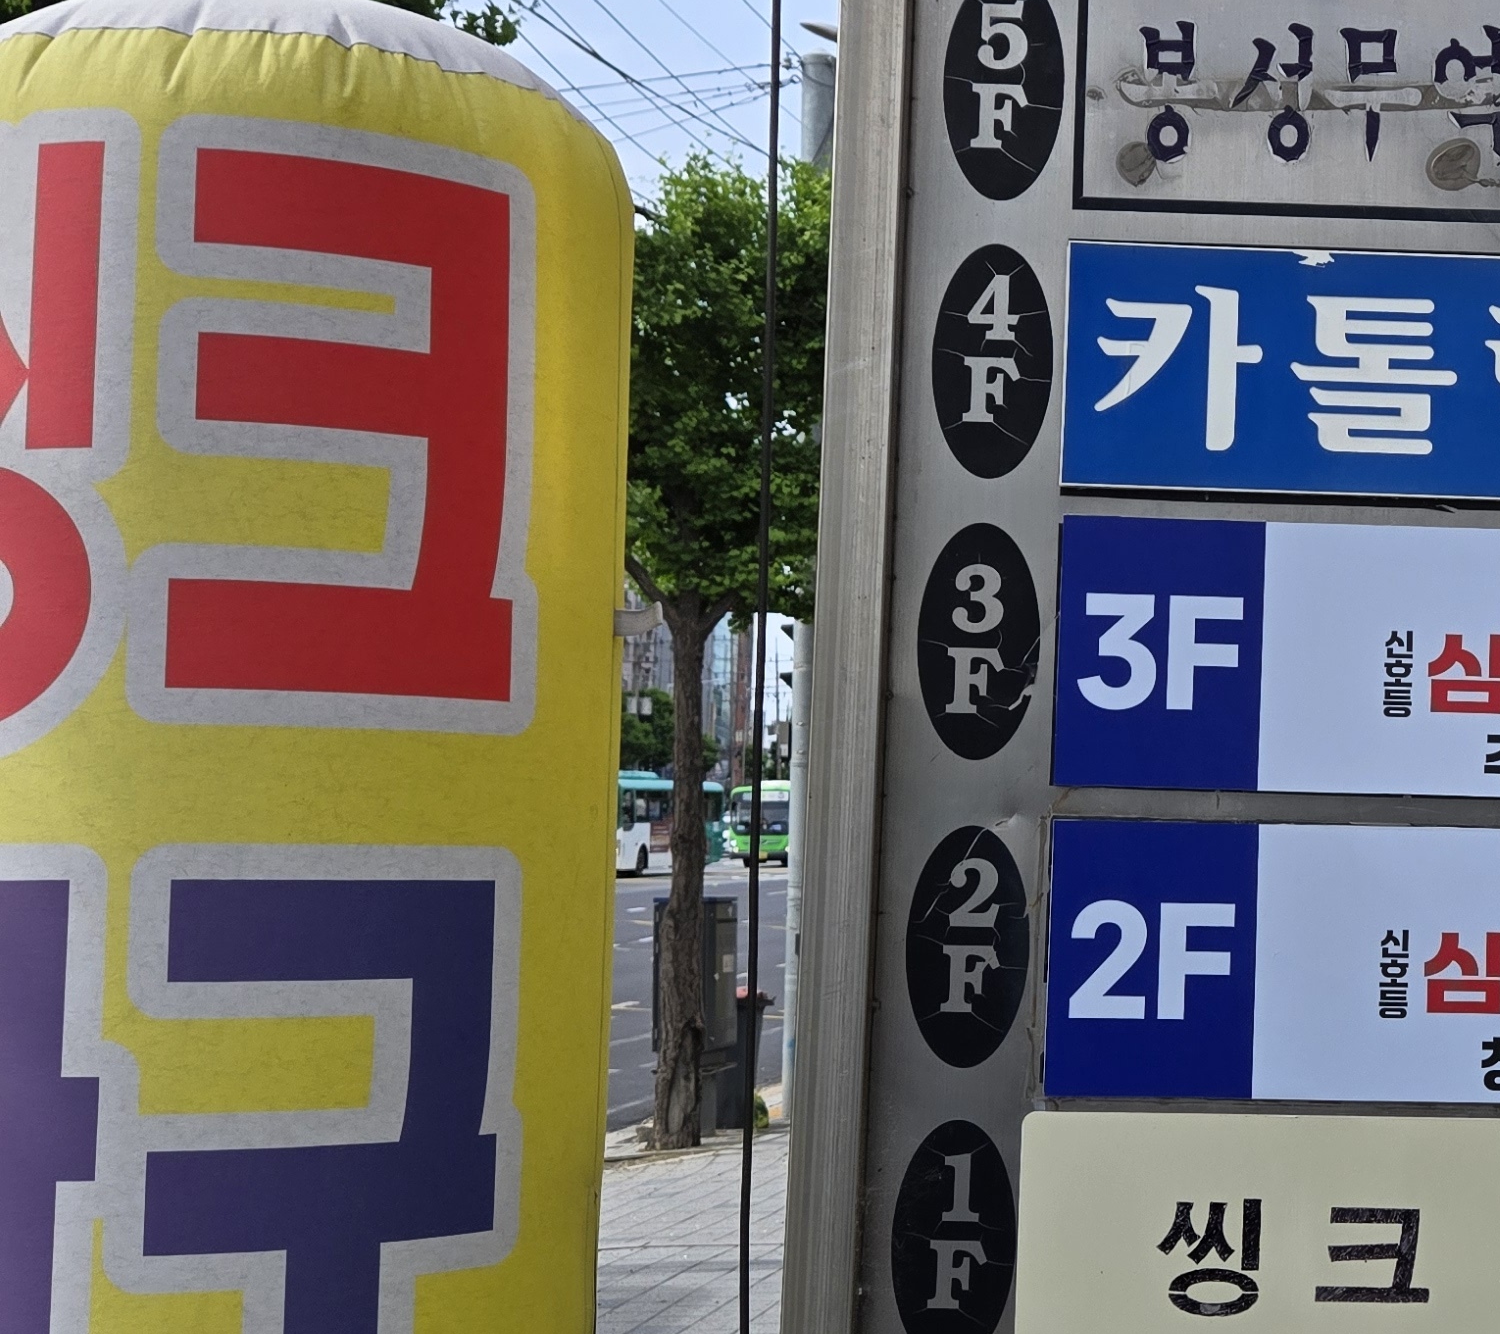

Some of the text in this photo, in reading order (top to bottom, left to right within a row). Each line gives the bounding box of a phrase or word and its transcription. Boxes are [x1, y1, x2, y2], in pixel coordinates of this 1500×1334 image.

[1077, 592, 1244, 711] 3F
[1383, 630, 1414, 718] 신호등
[1068, 899, 1236, 1020] 2F
[1379, 929, 1410, 1019] 신호등
[1157, 1198, 1430, 1317] 씽크
